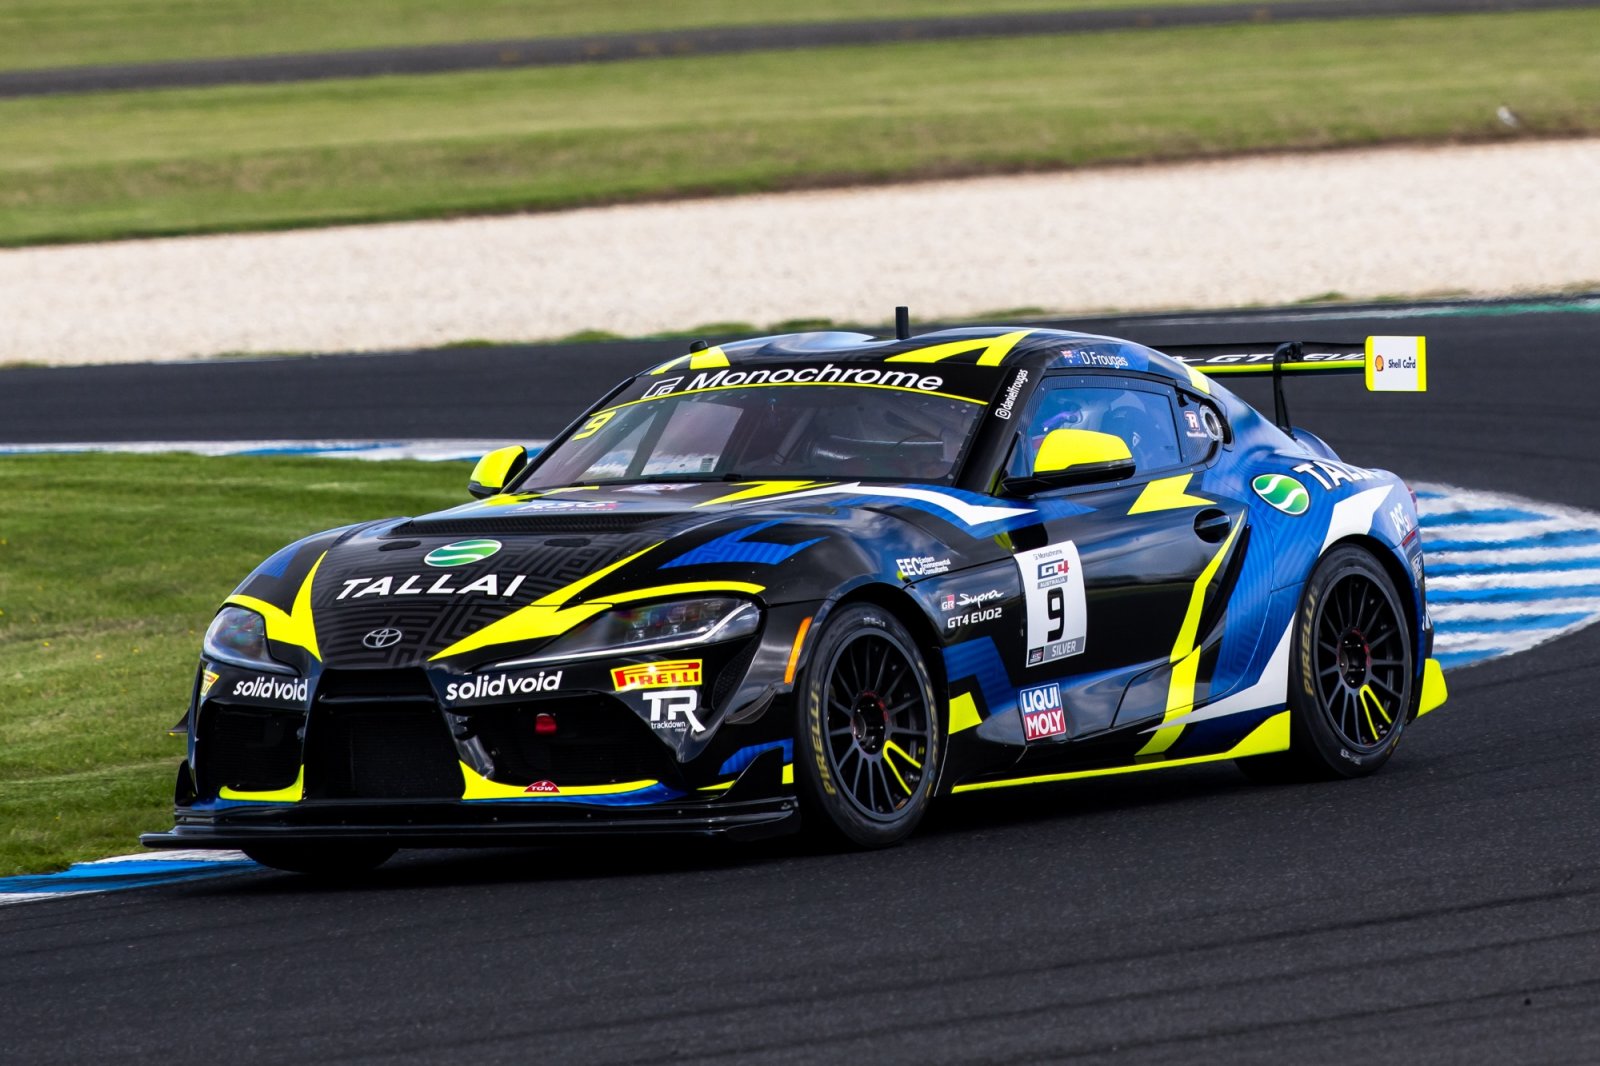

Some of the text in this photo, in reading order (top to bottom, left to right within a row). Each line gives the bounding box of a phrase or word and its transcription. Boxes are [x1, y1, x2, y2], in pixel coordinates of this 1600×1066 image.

[1080, 351, 1129, 369] D.Frougas
[1388, 356, 1416, 369] Shell Card
[684, 364, 944, 391] Monochrome
[571, 411, 617, 441] 9
[896, 557, 924, 576] EEC
[336, 574, 527, 600] TALLAI
[941, 589, 1004, 610] GR Supra
[947, 607, 1002, 629] GT4 EVO2
[1047, 586, 1065, 643] 9
[1051, 641, 1077, 657] SILVER
[1302, 593, 1316, 696] PIRELLI
[614, 662, 700, 688] PIRELLI
[642, 689, 706, 733] TR
[1022, 686, 1060, 713] LIQUI
[650, 721, 686, 730] trackdown
[1026, 710, 1062, 737] MOLY
[810, 689, 836, 795] PIRELLI
